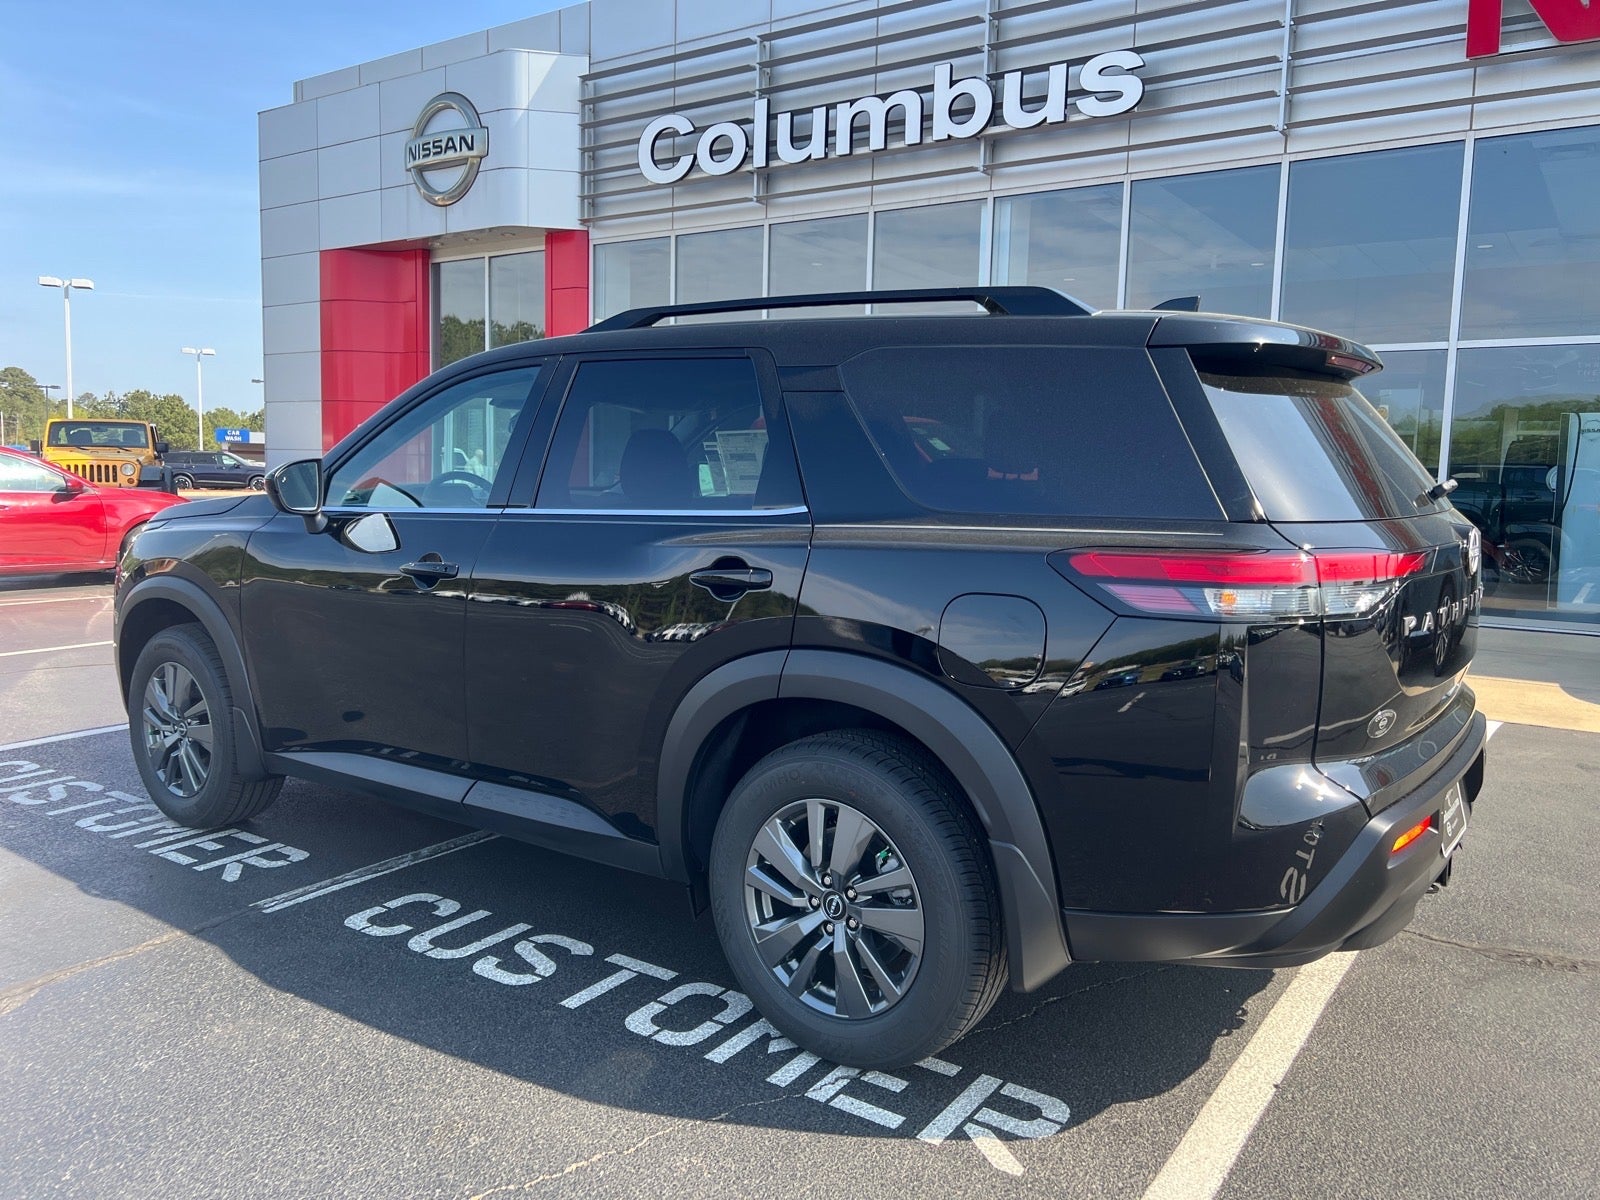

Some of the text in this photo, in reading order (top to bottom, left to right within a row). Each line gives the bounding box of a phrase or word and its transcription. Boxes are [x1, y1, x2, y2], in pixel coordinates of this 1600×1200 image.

[407, 134, 475, 164] NISSAN
[637, 50, 1147, 185] Columbus
[344, 892, 1071, 1177] CUSTOMER
